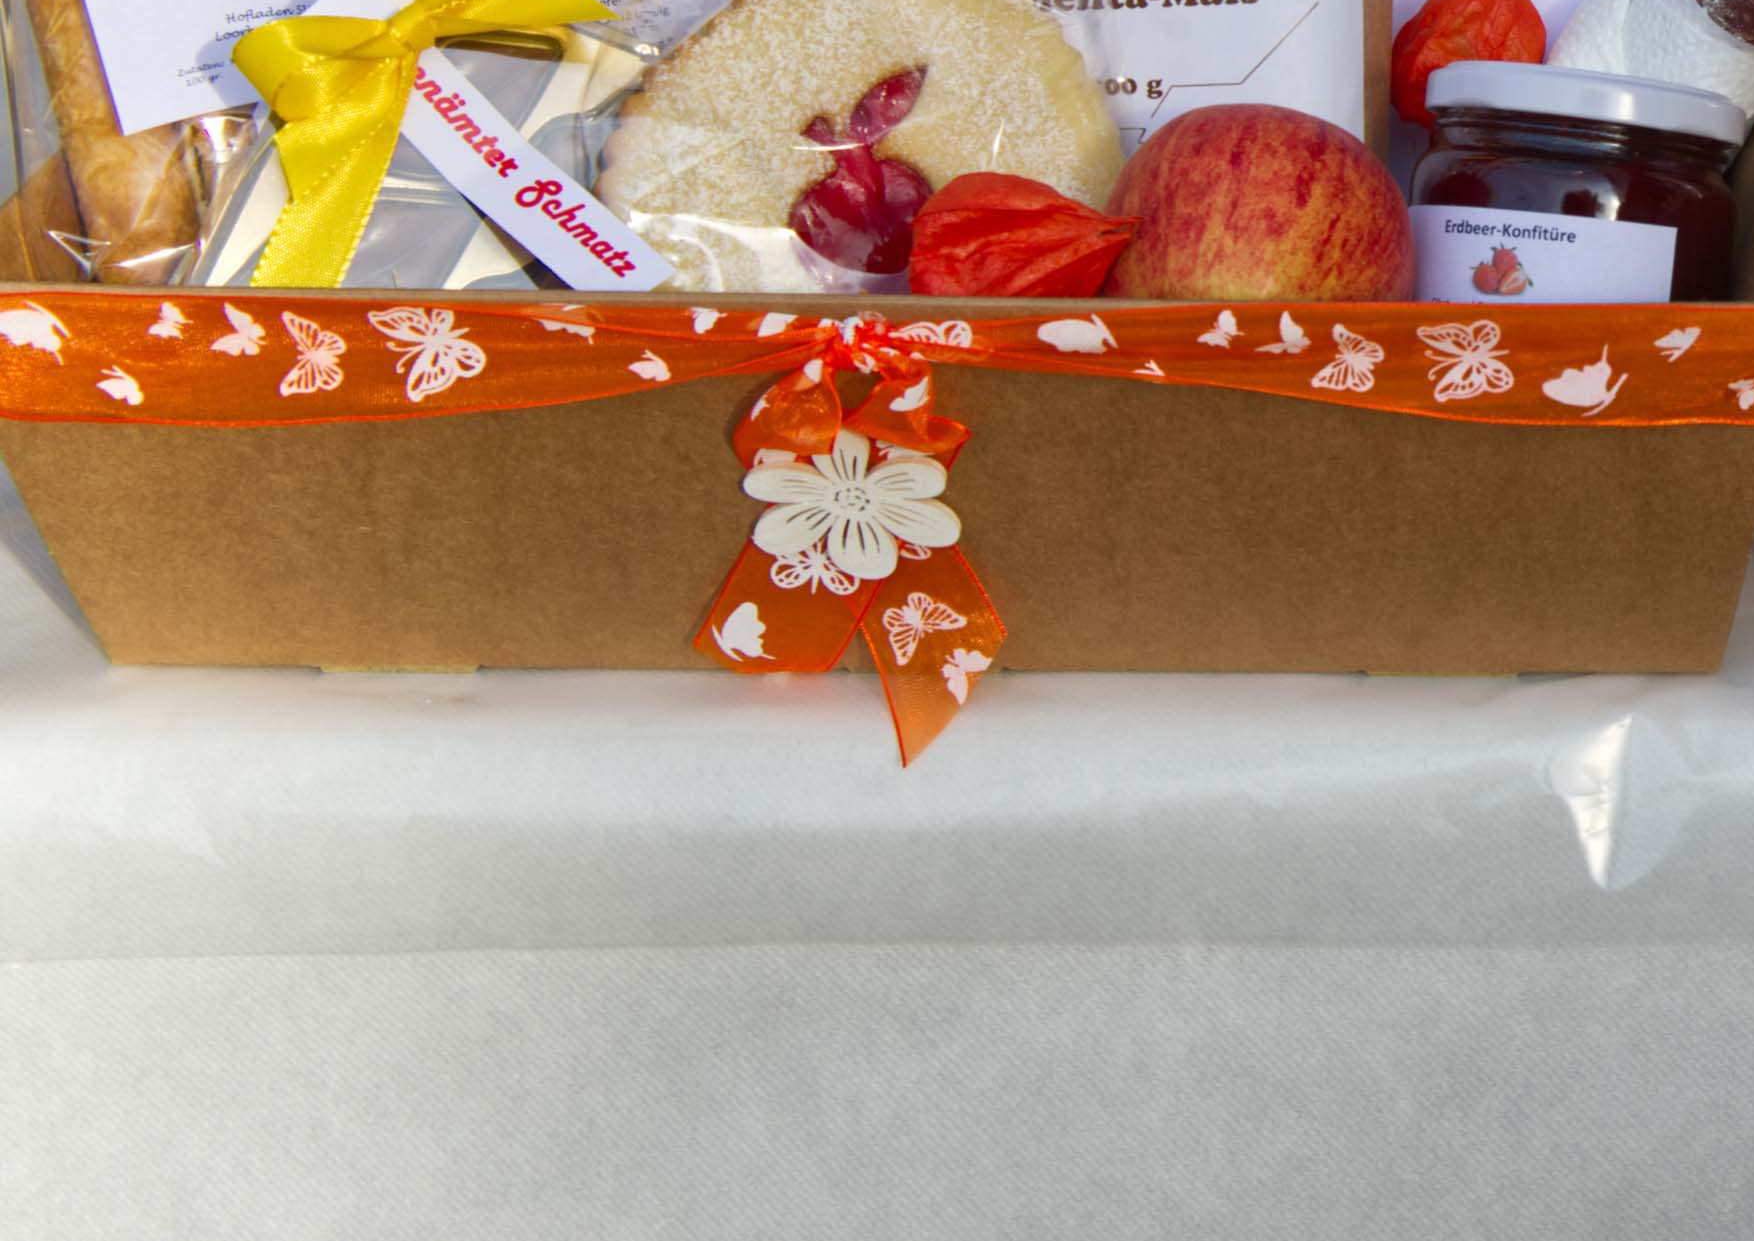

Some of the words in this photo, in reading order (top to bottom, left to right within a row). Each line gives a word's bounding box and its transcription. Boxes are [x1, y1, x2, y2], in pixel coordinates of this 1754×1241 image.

[1146, 78, 1164, 100] g
[513, 178, 637, 279] Schmatz
[1444, 218, 1577, 244] Erdbeer-Konfitüre
